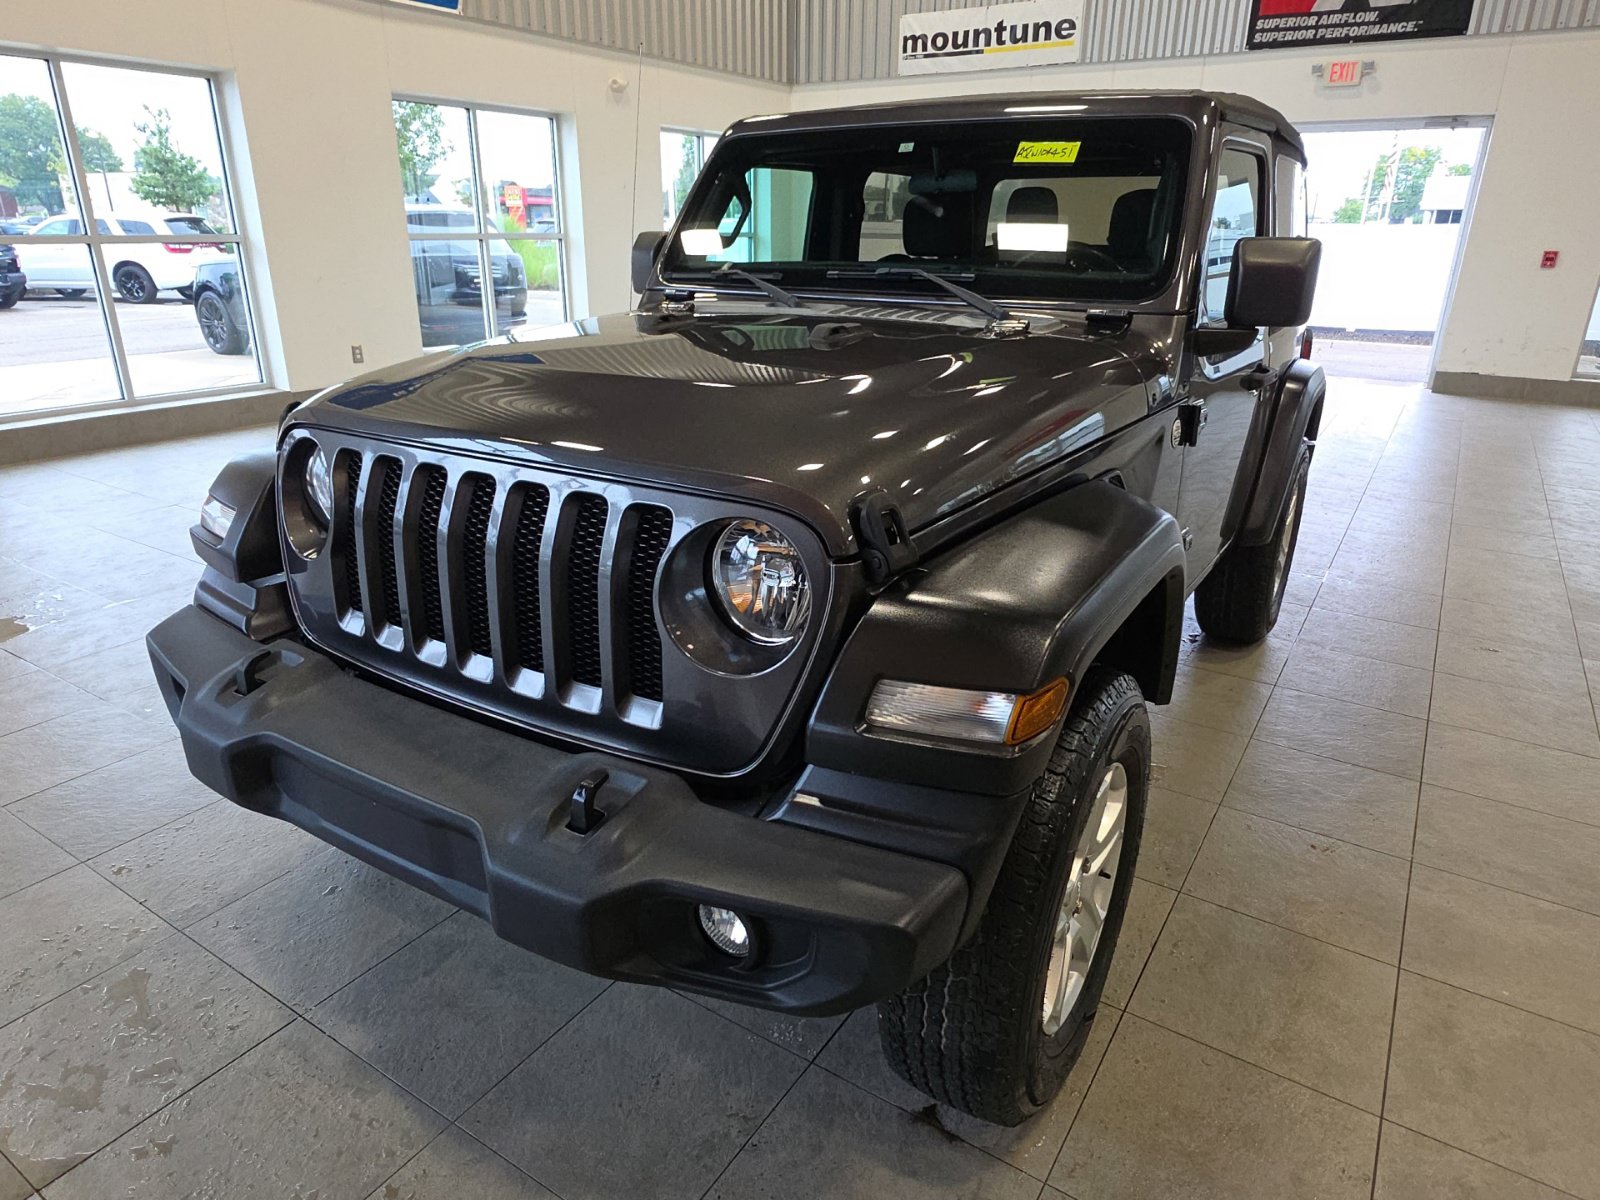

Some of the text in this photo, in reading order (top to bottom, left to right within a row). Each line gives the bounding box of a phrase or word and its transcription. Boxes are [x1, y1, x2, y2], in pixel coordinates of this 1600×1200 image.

[1255, 11, 1380, 29] SUPERIOR AIRFLOW.
[902, 18, 1077, 54] mountune
[1253, 29, 1316, 42] SUPERIOR
[1328, 61, 1360, 82] EXIT
